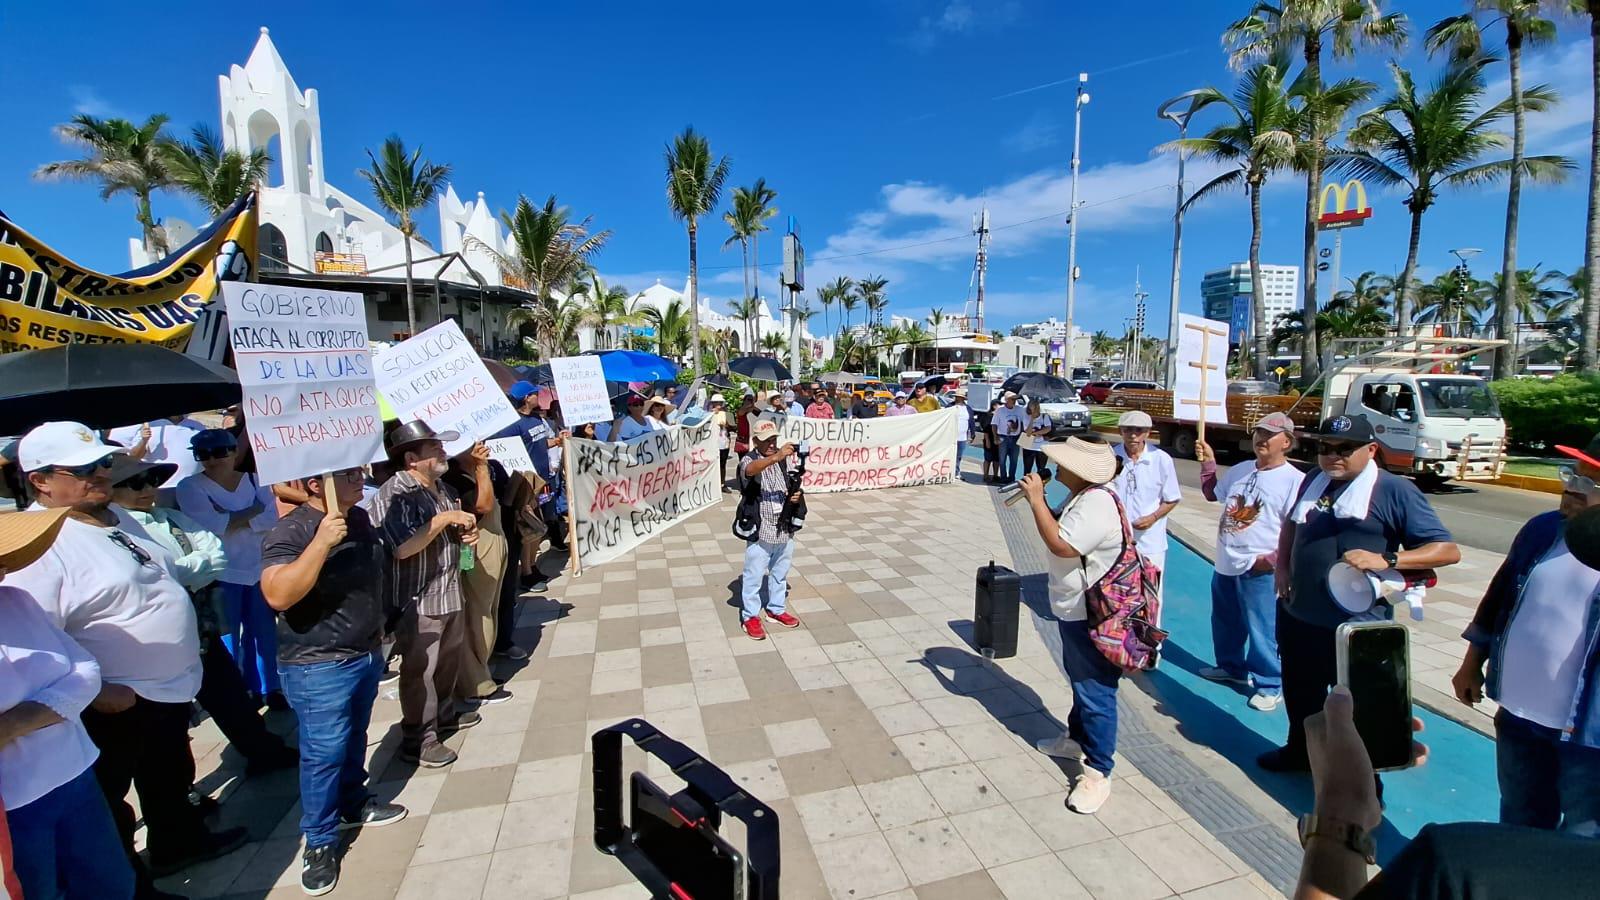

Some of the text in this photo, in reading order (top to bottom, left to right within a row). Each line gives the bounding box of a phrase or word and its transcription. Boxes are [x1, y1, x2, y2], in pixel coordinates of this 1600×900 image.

[136, 294, 205, 329] UAS
[241, 288, 355, 318] GOBIERNO
[233, 327, 365, 350] ATACA AL CORRUPTO
[259, 353, 368, 380] DE LA UAS
[383, 330, 464, 378] SOLUCION
[249, 385, 377, 417] NO ATAQUES
[389, 386, 411, 406] NO
[470, 397, 509, 427] PRIMAS
[253, 416, 377, 453] AL TRABAJADOR
[577, 444, 603, 477] NO
[607, 445, 620, 476] A
[625, 439, 655, 469] LAS
[877, 446, 890, 461] DE
[899, 443, 923, 460] LOS
[802, 459, 951, 487] BAJADORES NO SE
[577, 519, 601, 558] EN
[630, 479, 713, 537] EDUCACIÓN
